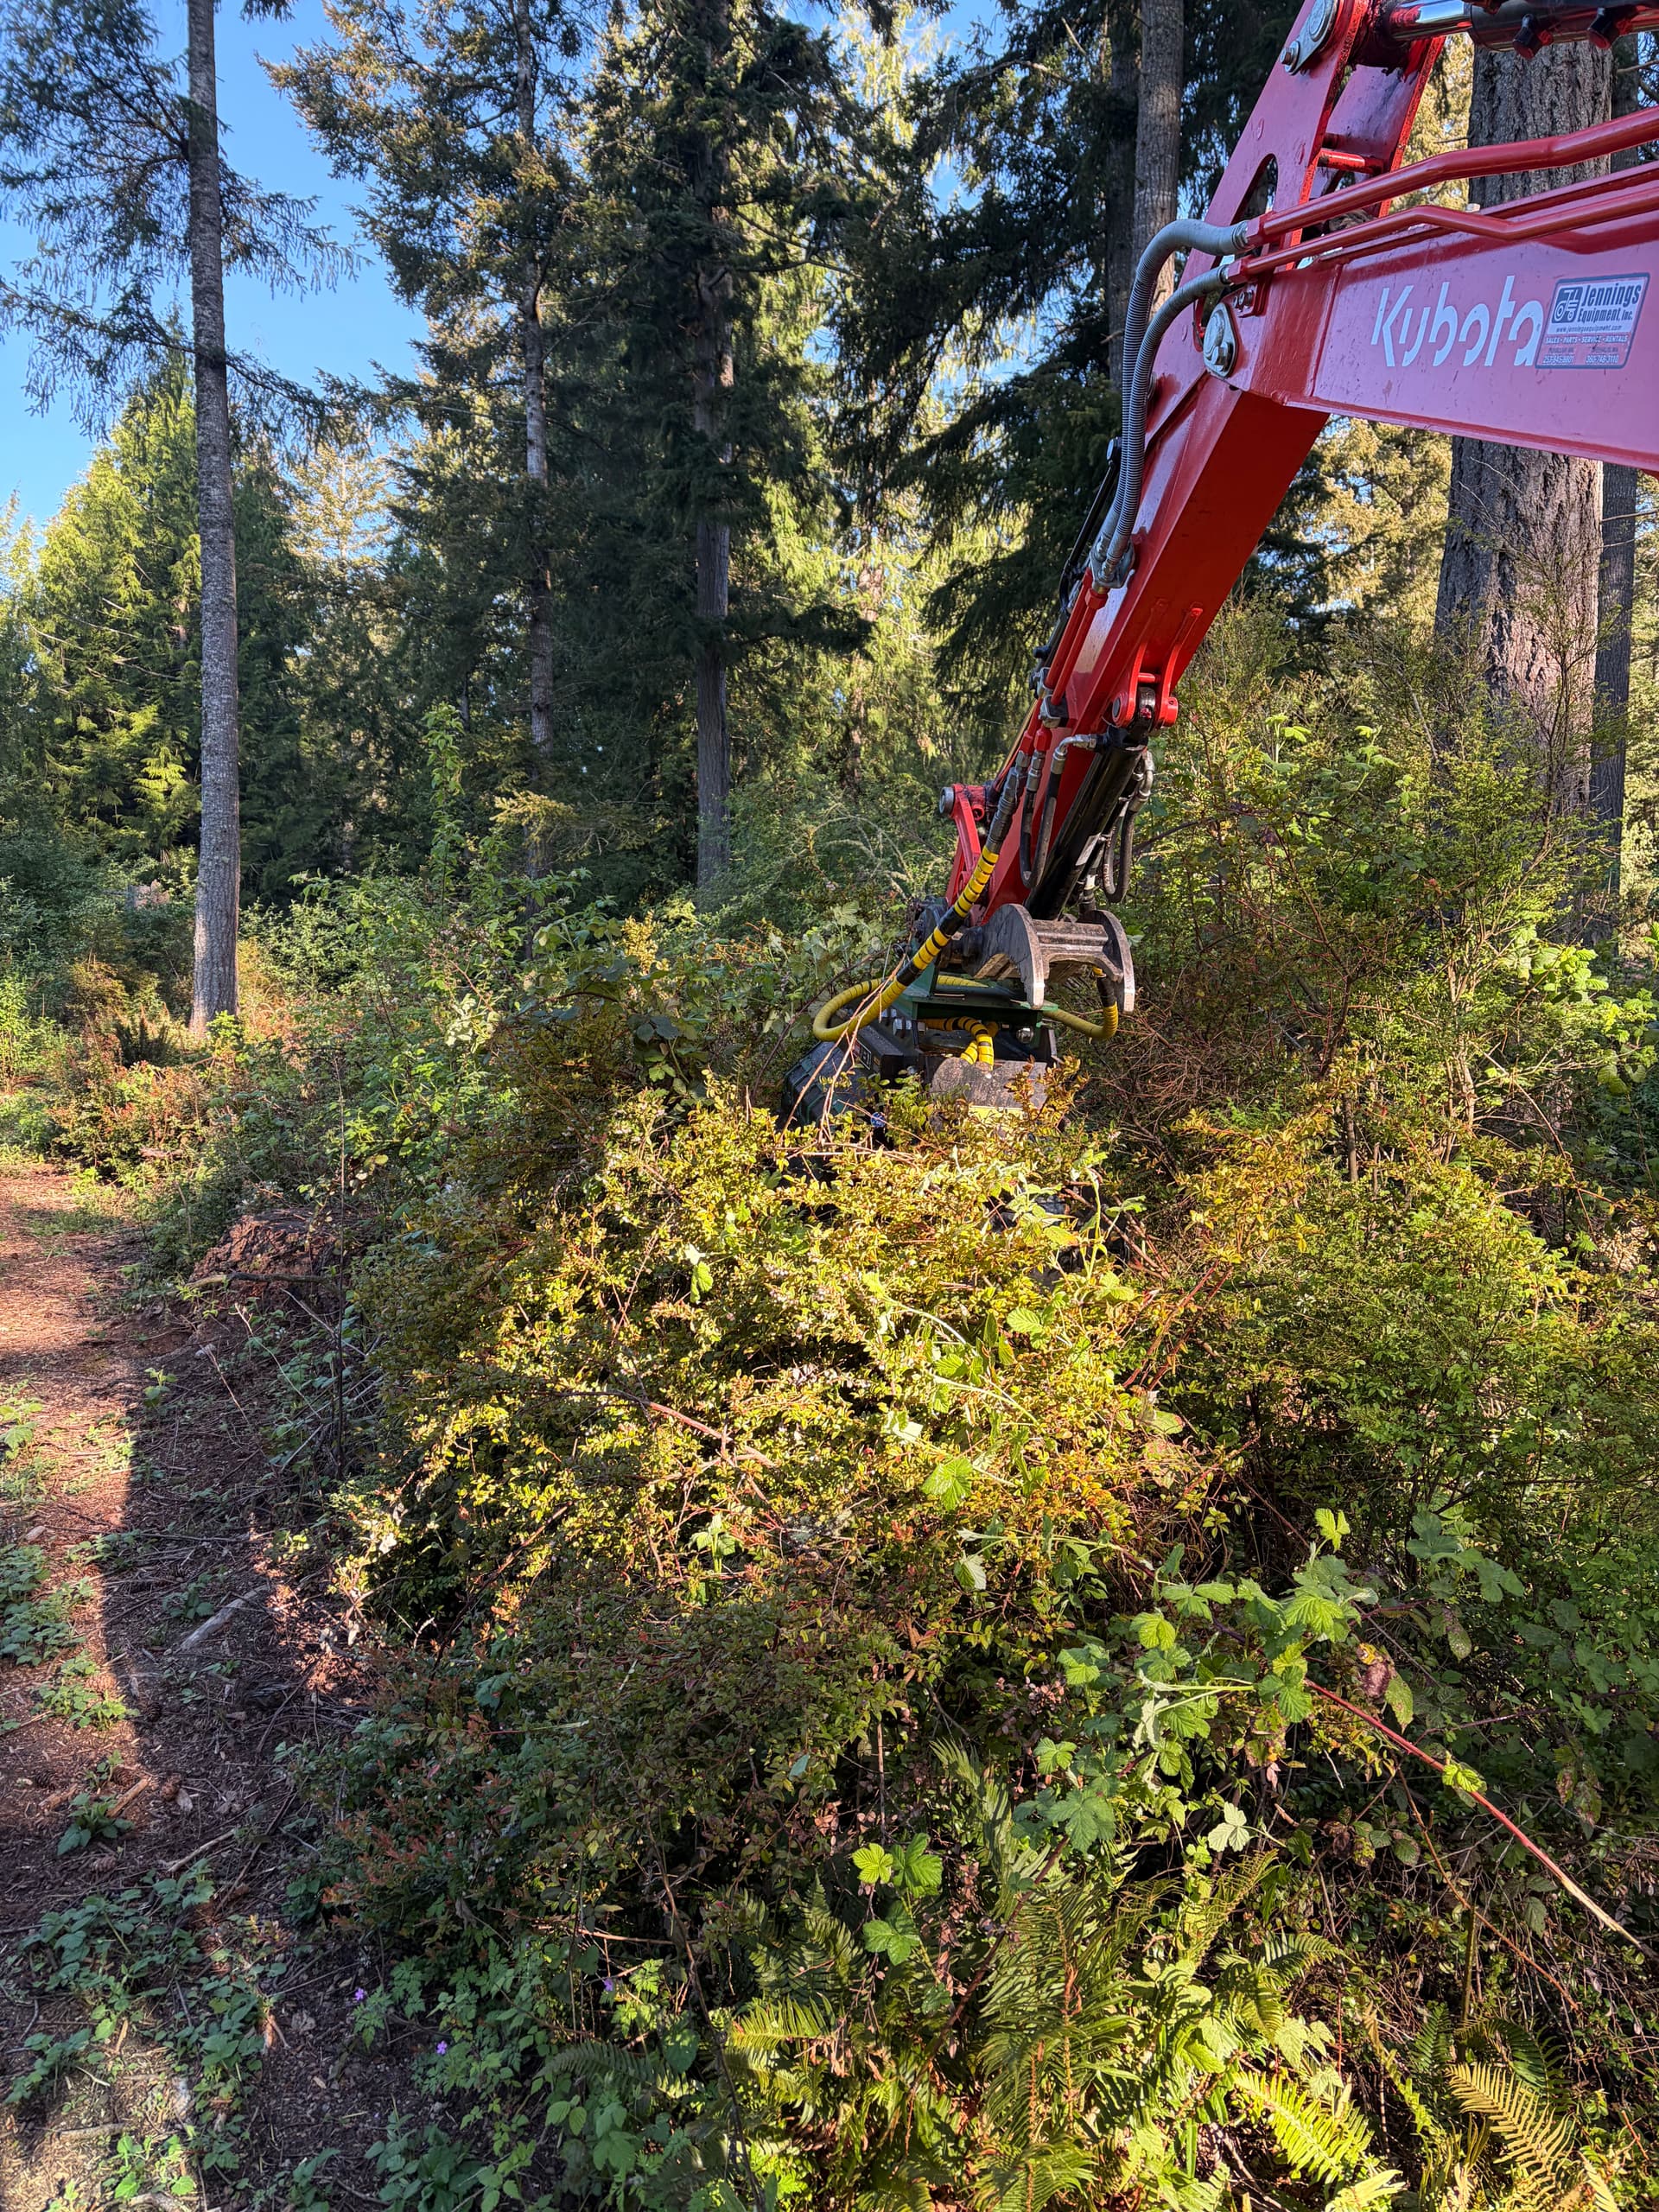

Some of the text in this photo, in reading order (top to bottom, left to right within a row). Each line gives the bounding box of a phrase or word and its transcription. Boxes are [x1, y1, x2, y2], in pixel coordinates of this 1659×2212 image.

[1581, 283, 1642, 308] Jennings
[1370, 275, 1544, 367] Kubota
[1621, 309, 1633, 321] Inc.
